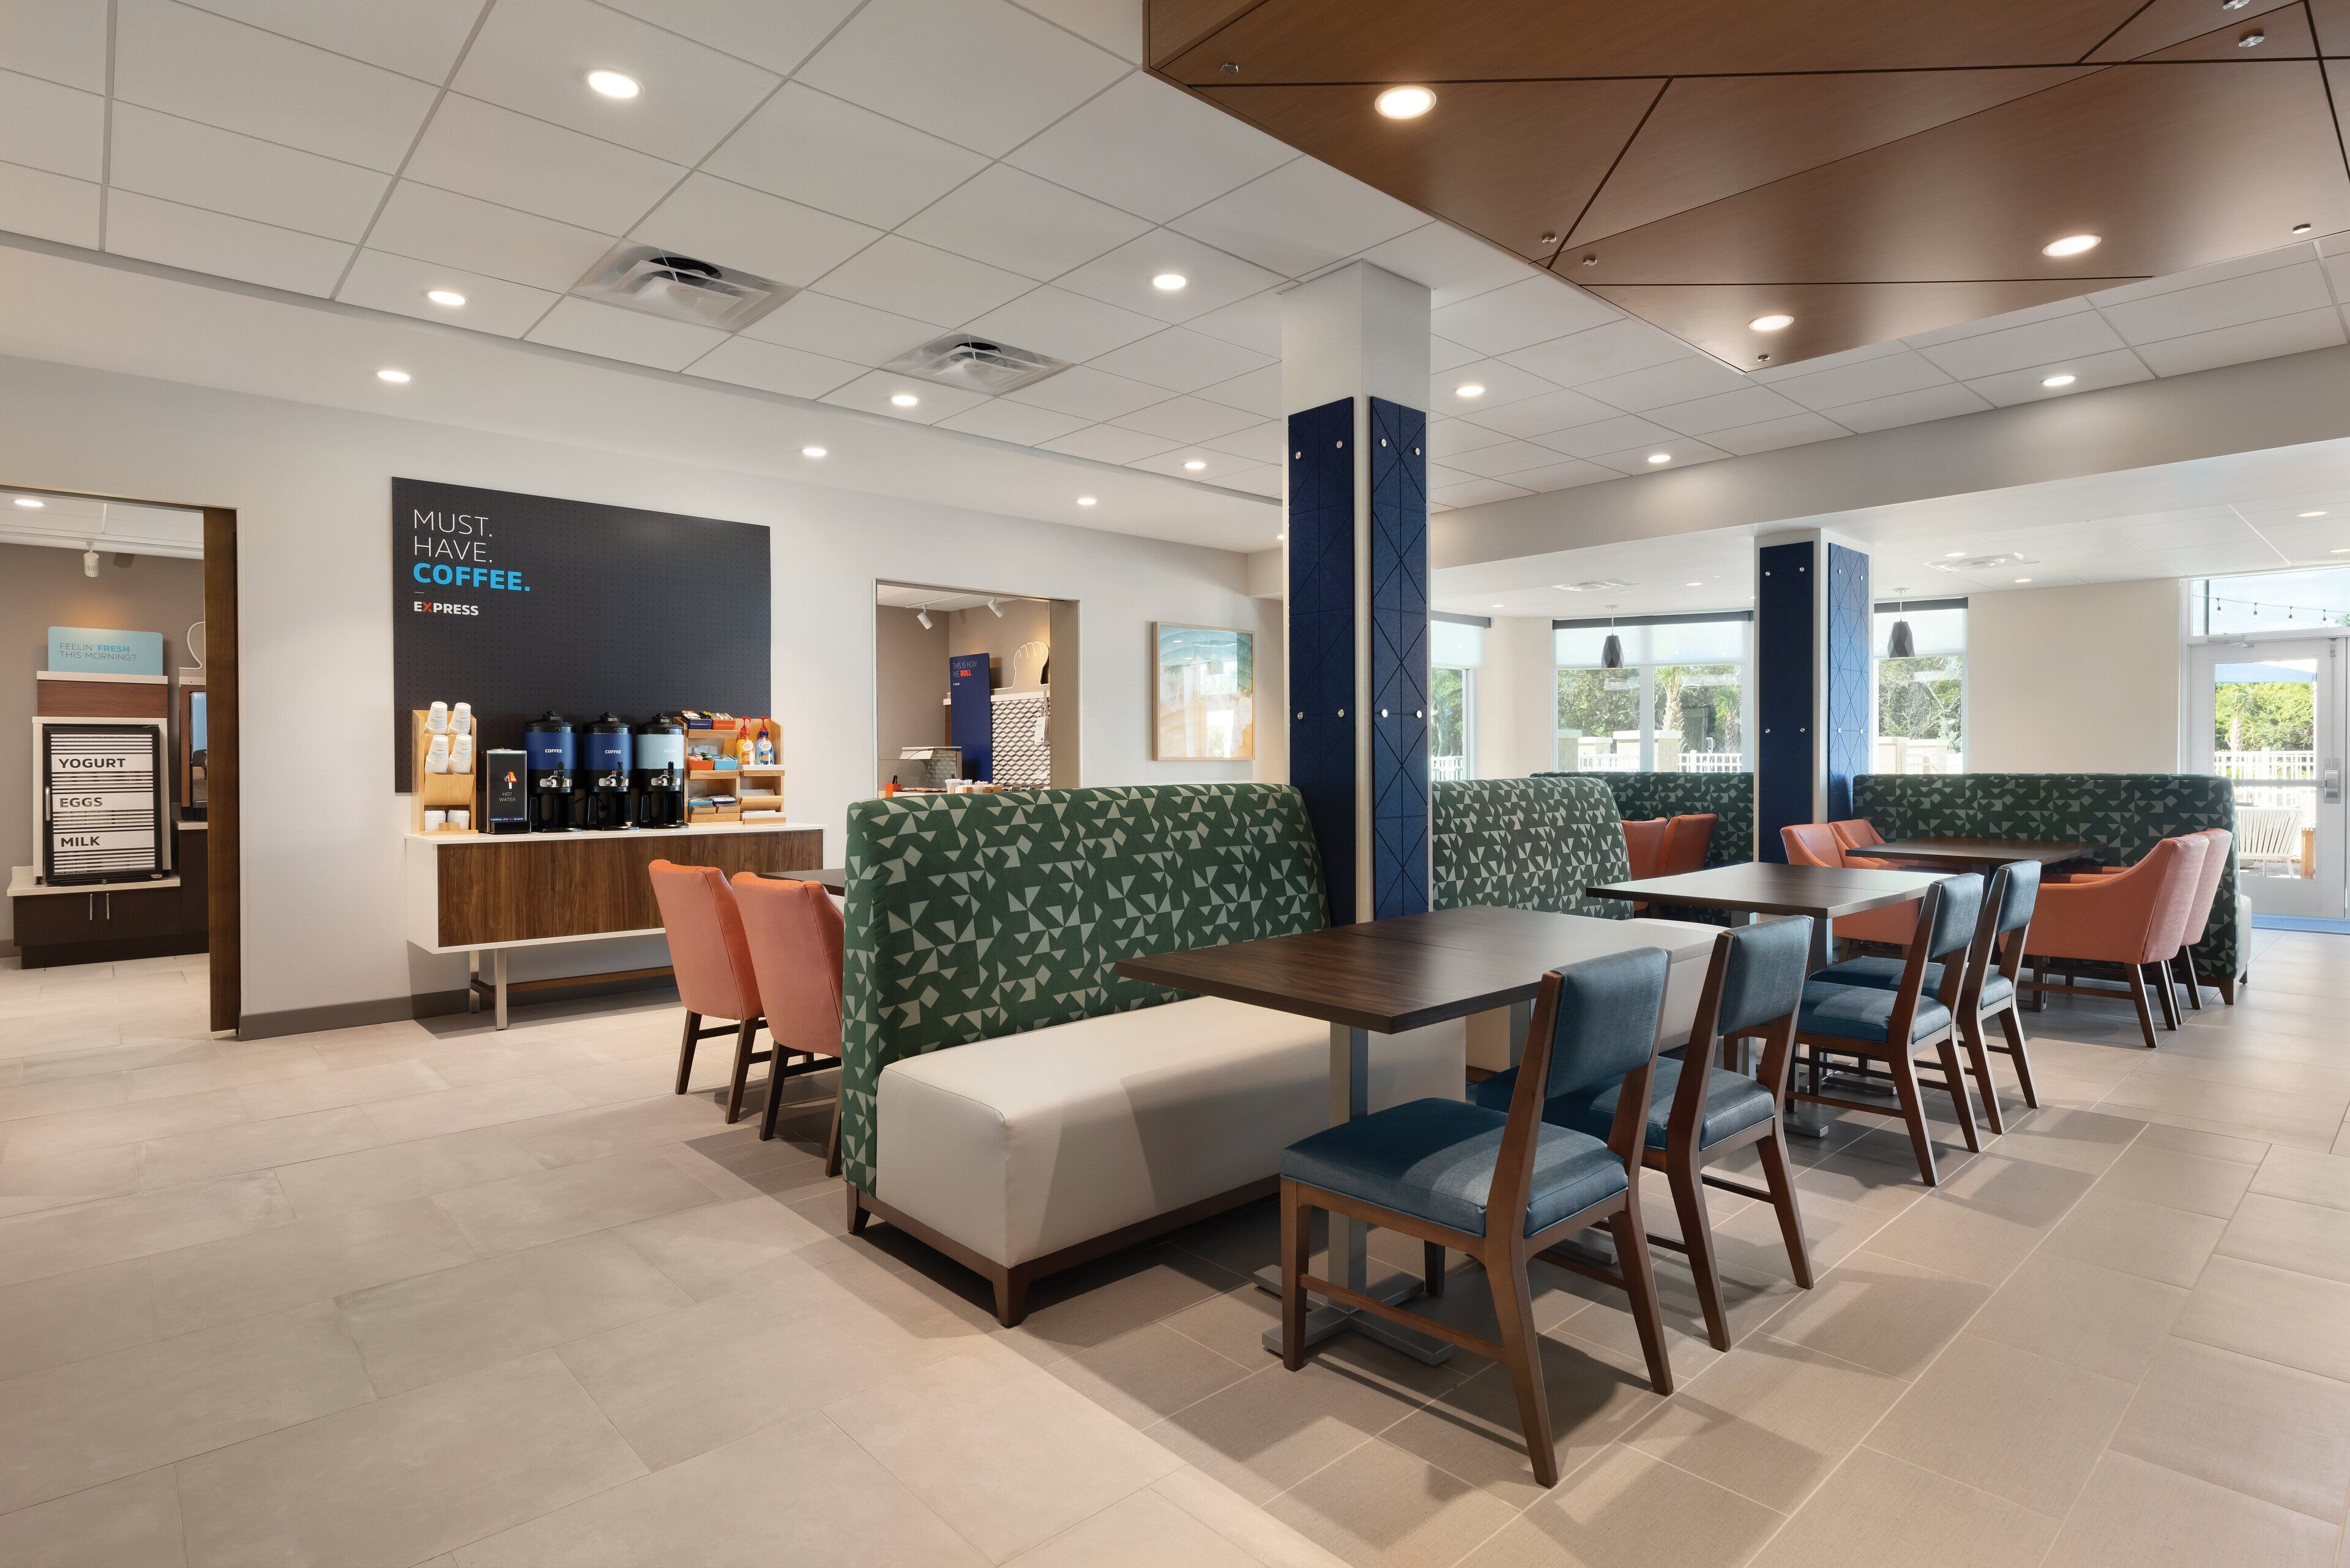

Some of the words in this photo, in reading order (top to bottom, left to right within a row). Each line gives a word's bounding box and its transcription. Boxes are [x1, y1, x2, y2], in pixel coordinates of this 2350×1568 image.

[414, 509, 492, 537] MUST.
[414, 536, 492, 562] HAVE.
[413, 562, 531, 591] COFFEE.
[414, 601, 479, 616] EXPRESS
[85, 652, 136, 661] MORNING?
[58, 758, 125, 768] YOGURT
[59, 797, 103, 807] EGGS
[61, 837, 100, 847] MILK
